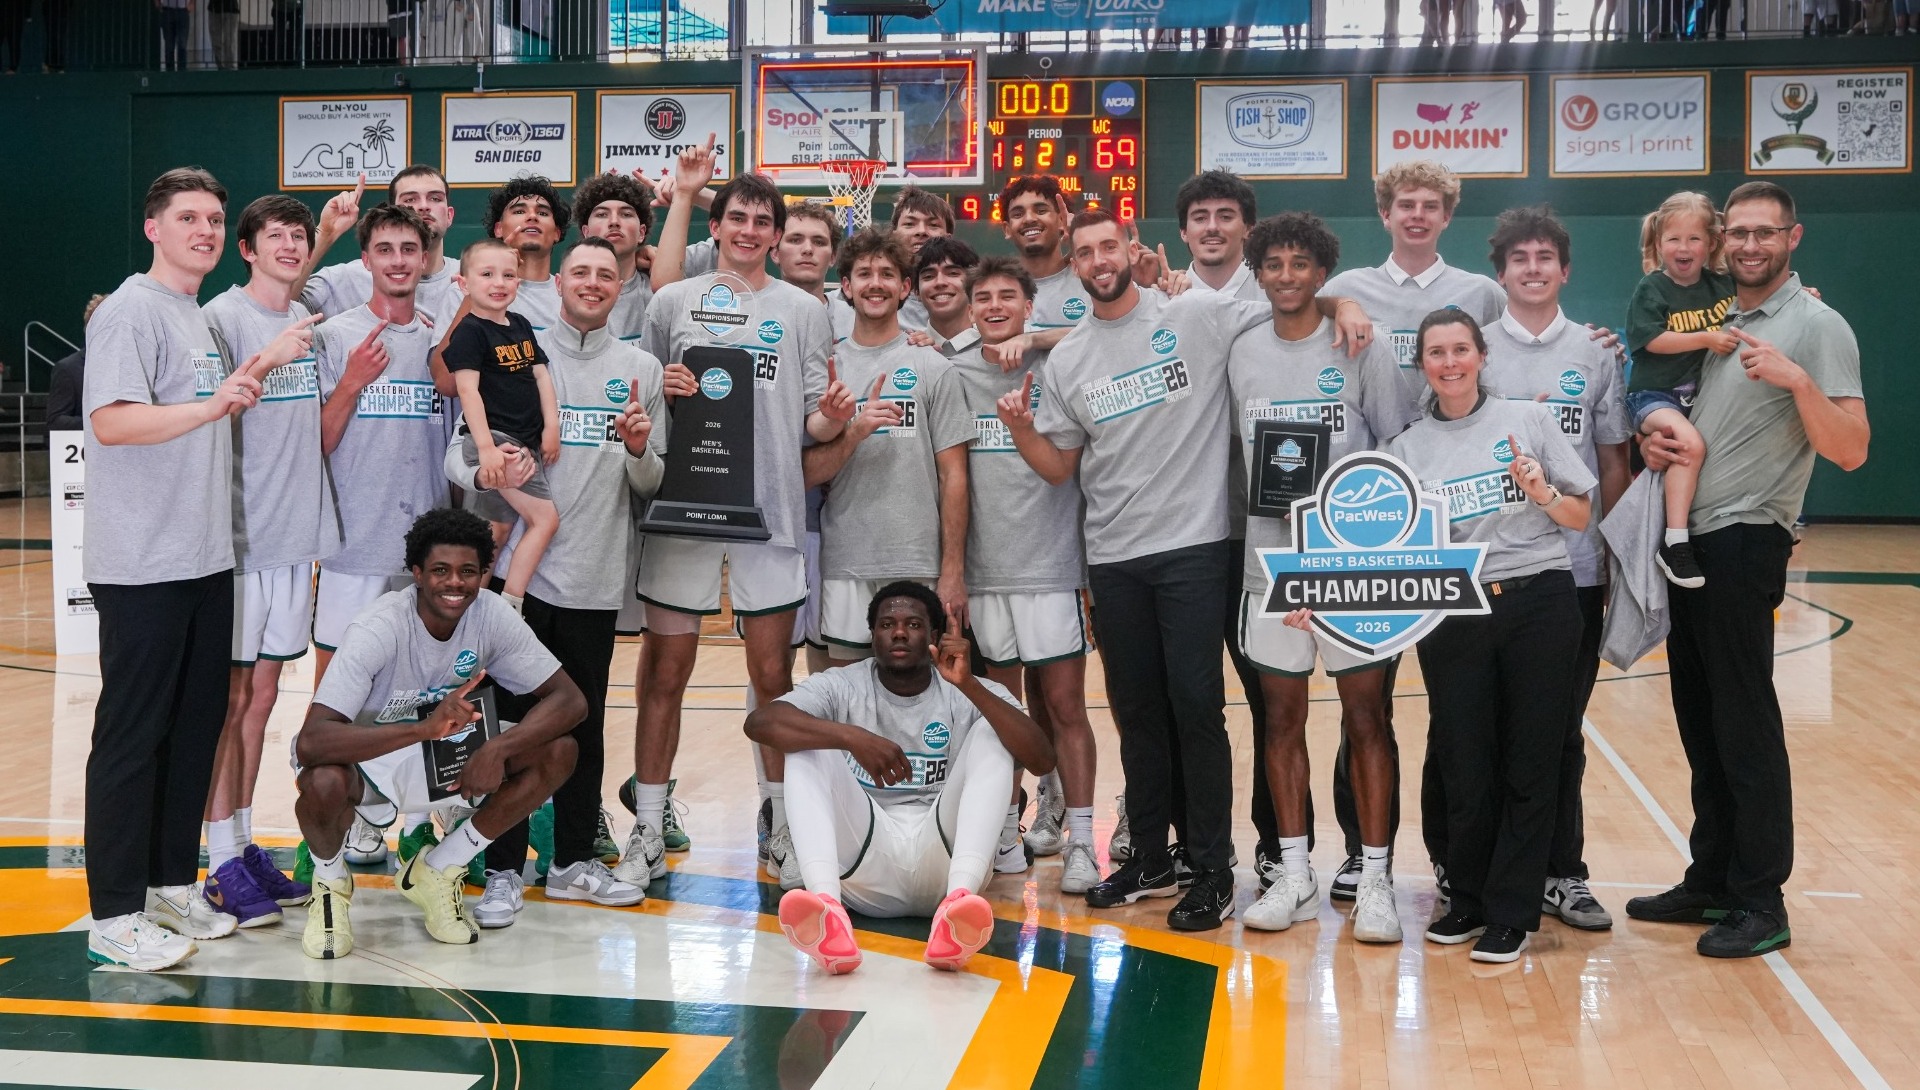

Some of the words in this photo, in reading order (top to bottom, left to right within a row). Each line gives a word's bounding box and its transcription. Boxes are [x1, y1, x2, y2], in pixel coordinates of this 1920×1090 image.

[1836, 78, 1904, 88] REGISTER
[1001, 83, 1069, 114] 00.0
[1853, 89, 1887, 99] NOW
[322, 104, 368, 112] PLN-YOU
[1105, 97, 1135, 107] NCAA
[1236, 107, 1260, 128] FISH
[1278, 107, 1307, 127] SHOP
[1570, 103, 1590, 122] V
[1603, 101, 1698, 121] GROUP
[455, 128, 483, 138] XTRA
[534, 127, 561, 138] 1360
[495, 123, 522, 136] FOX
[1028, 128, 1063, 139] PERIOD
[1092, 119, 1111, 134] WC
[828, 141, 855, 150] Lom
[1392, 127, 1509, 150] DUNKIN'
[1566, 136, 1621, 156] signs
[1642, 135, 1694, 155] print
[474, 150, 501, 163] SAN
[502, 150, 542, 162] DIEGO
[605, 145, 662, 159] JIMMY
[665, 144, 725, 158] JO'S
[1037, 142, 1053, 166] 2
[1096, 138, 1135, 169] 69
[1013, 156, 1023, 167] B
[1067, 155, 1077, 167] B
[292, 170, 324, 178] DAWSON
[1059, 177, 1082, 192] OUL
[1111, 176, 1136, 191] FLS
[1083, 192, 1102, 200] T.O.L.
[963, 198, 978, 219] 9
[1120, 197, 1134, 220] 6
[693, 313, 745, 323] CHAMPIONSHIPS
[268, 366, 303, 376] SKETBALL
[756, 352, 778, 381] 26
[1162, 361, 1189, 392] 26
[360, 385, 411, 395] ASKETBALL
[1085, 377, 1138, 402] BASKETBALL
[358, 394, 412, 412] CHAMPS
[1089, 385, 1144, 419] CHAMPS
[1246, 407, 1294, 419] BASKETBALL
[1321, 404, 1345, 432] 26
[1560, 406, 1583, 435] 26
[691, 447, 731, 455] BASKETBALL
[690, 465, 729, 474] CHAMPIONS
[686, 511, 706, 519] POINT
[707, 513, 728, 521] LOMA
[1334, 510, 1404, 523] PacWest
[1300, 556, 1343, 568] MEN'S
[1348, 554, 1443, 567] BASKETBALL
[1285, 576, 1461, 604] CHAMPIONS
[1355, 621, 1391, 633] 2026
[925, 759, 948, 786] 26
